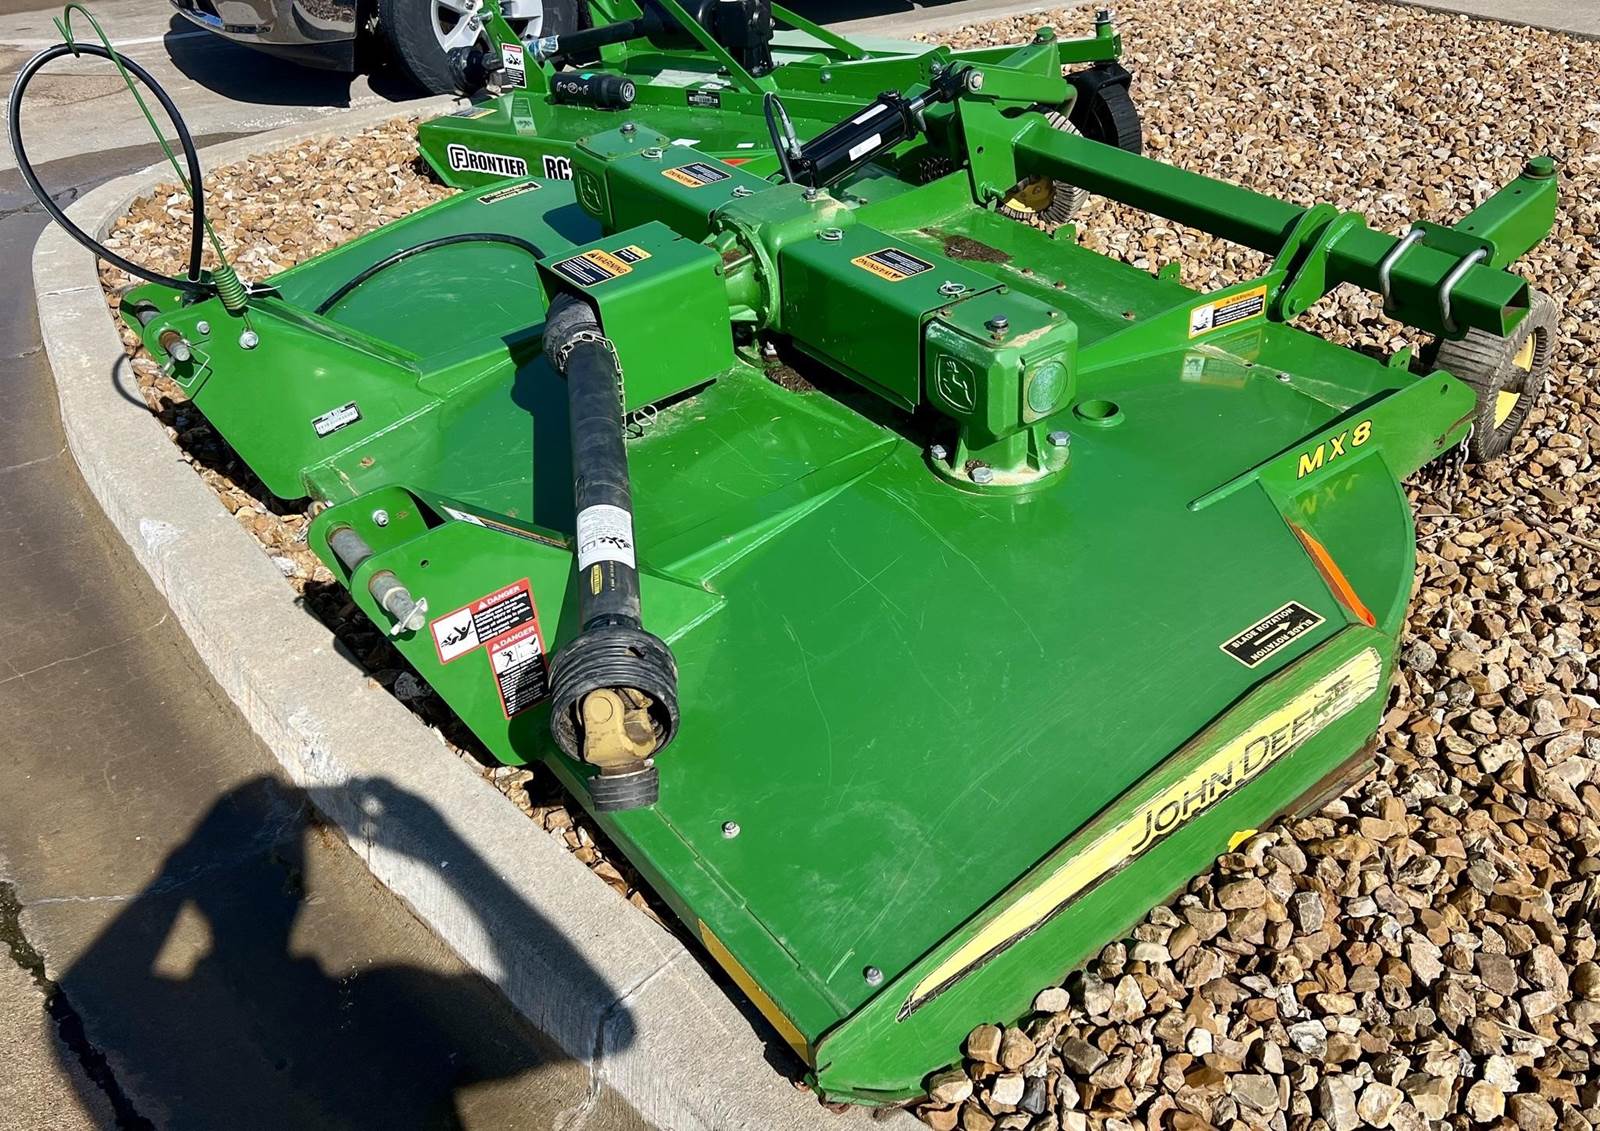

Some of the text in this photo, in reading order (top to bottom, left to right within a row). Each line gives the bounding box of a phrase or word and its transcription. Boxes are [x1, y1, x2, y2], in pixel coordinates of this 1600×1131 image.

[449, 145, 572, 180] FRONTIER RC
[487, 585, 521, 605] DANGER
[500, 625, 535, 647] DANGER
[1231, 607, 1295, 649] BLADE ROTATION
[1249, 619, 1315, 661] BLADE ROTATION
[1131, 761, 1234, 852] JOHN
